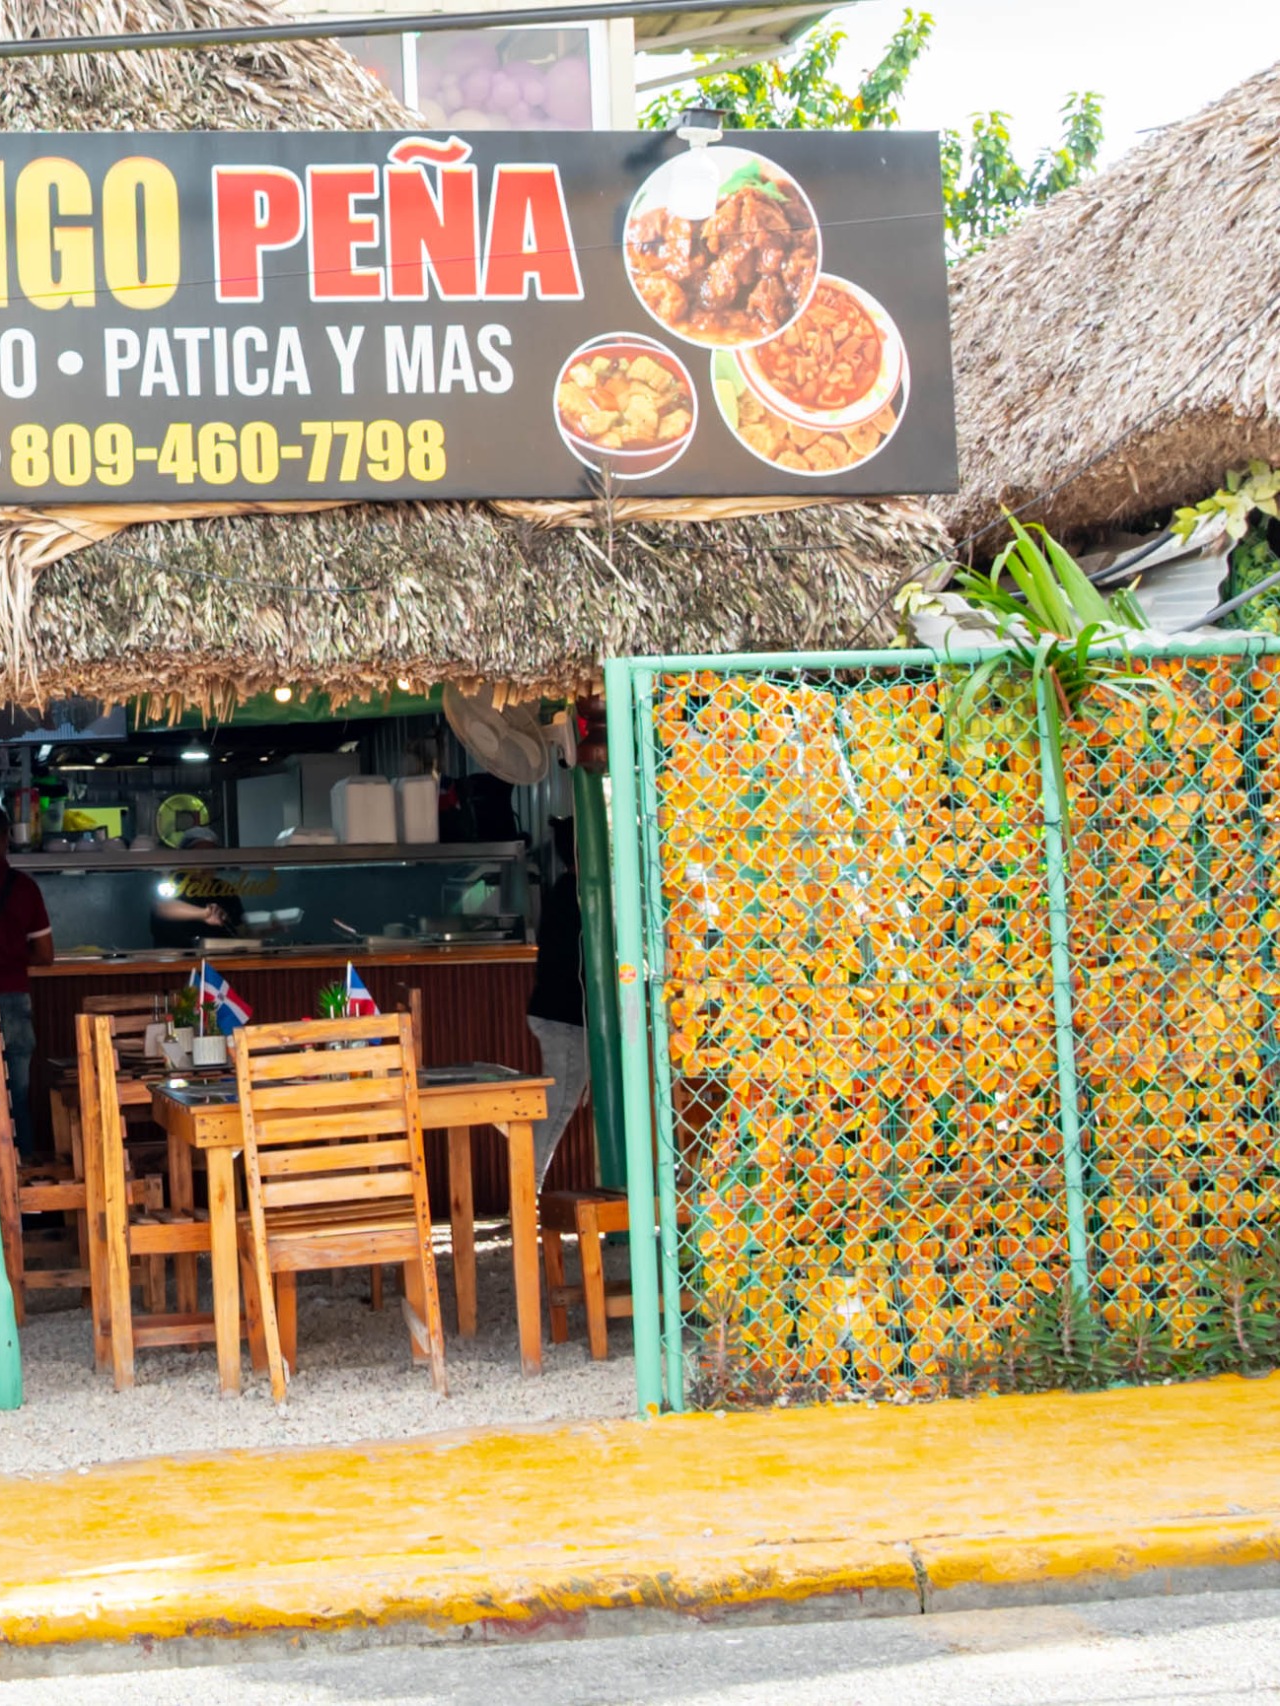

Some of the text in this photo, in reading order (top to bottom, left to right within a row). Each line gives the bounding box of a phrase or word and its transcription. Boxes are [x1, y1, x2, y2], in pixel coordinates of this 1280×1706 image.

[211, 136, 585, 304] PEÑA
[104, 325, 312, 397] PATICA
[325, 325, 365, 395] Y
[384, 323, 515, 395] MAS
[10, 419, 447, 487] 809-460-7798
